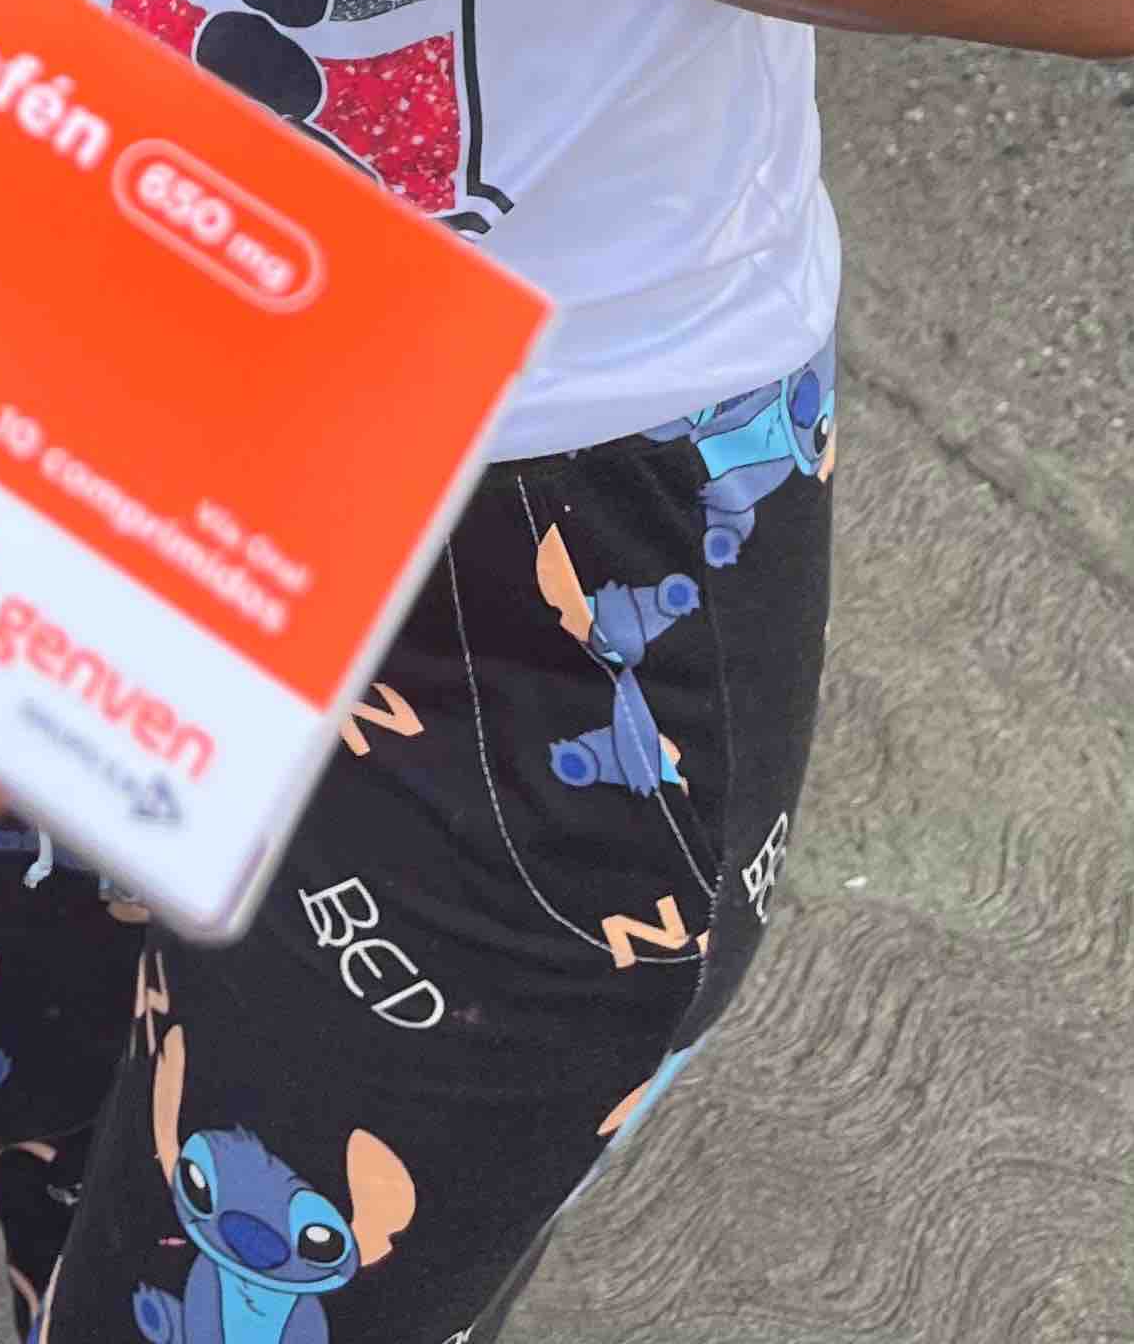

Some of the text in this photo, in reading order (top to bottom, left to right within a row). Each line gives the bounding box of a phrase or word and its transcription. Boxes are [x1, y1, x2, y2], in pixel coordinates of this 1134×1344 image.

[138, 163, 296, 294] 650 mg
[40, 446, 290, 634] comprimidos
[297, 876, 446, 1030] BED
